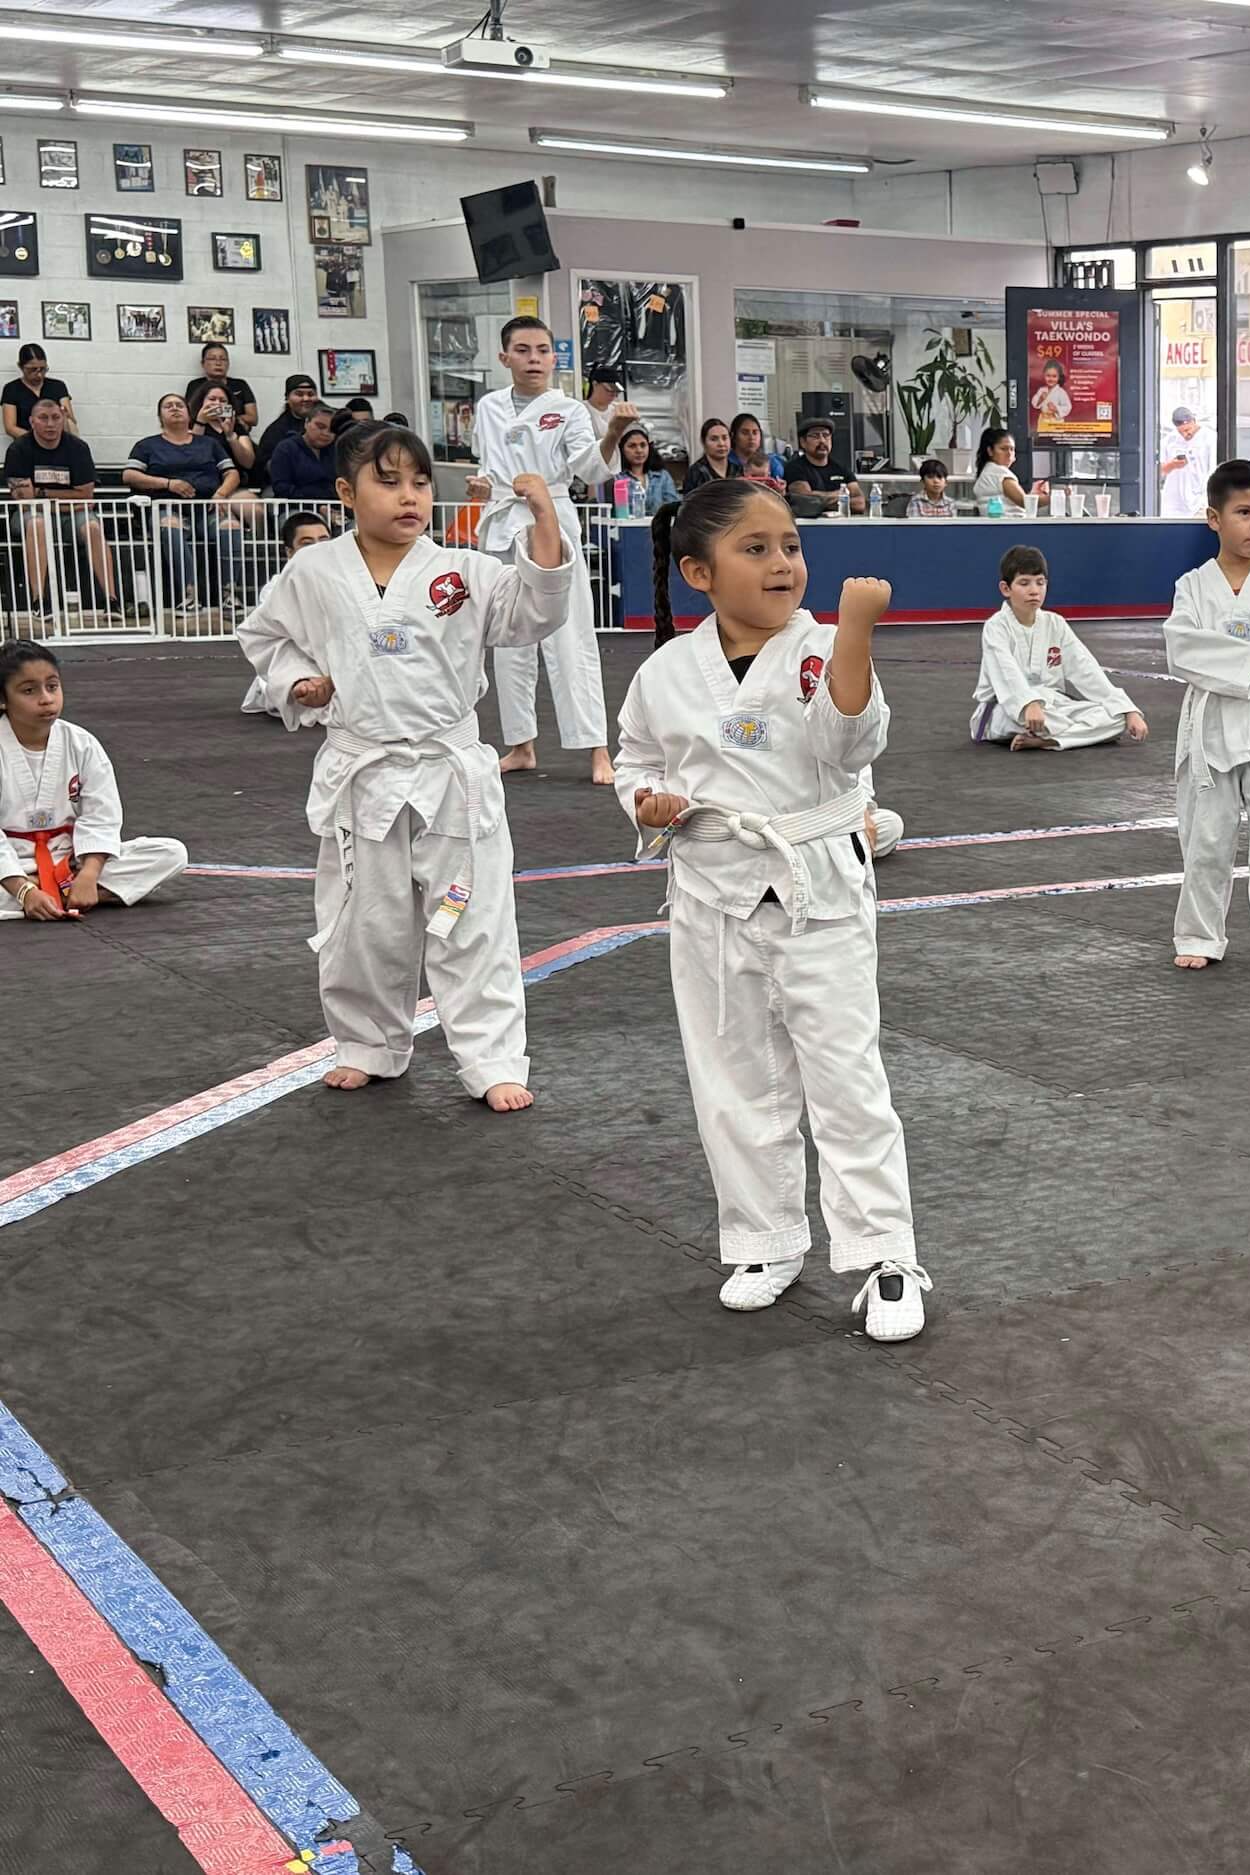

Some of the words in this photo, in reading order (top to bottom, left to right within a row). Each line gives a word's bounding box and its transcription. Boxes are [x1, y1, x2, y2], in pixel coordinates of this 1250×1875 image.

[1076, 311, 1110, 319] SPECIAL
[1050, 321, 1094, 331] VILLA'S
[1034, 331, 1111, 342] TAEKWONDO
[1037, 345, 1062, 358] $49
